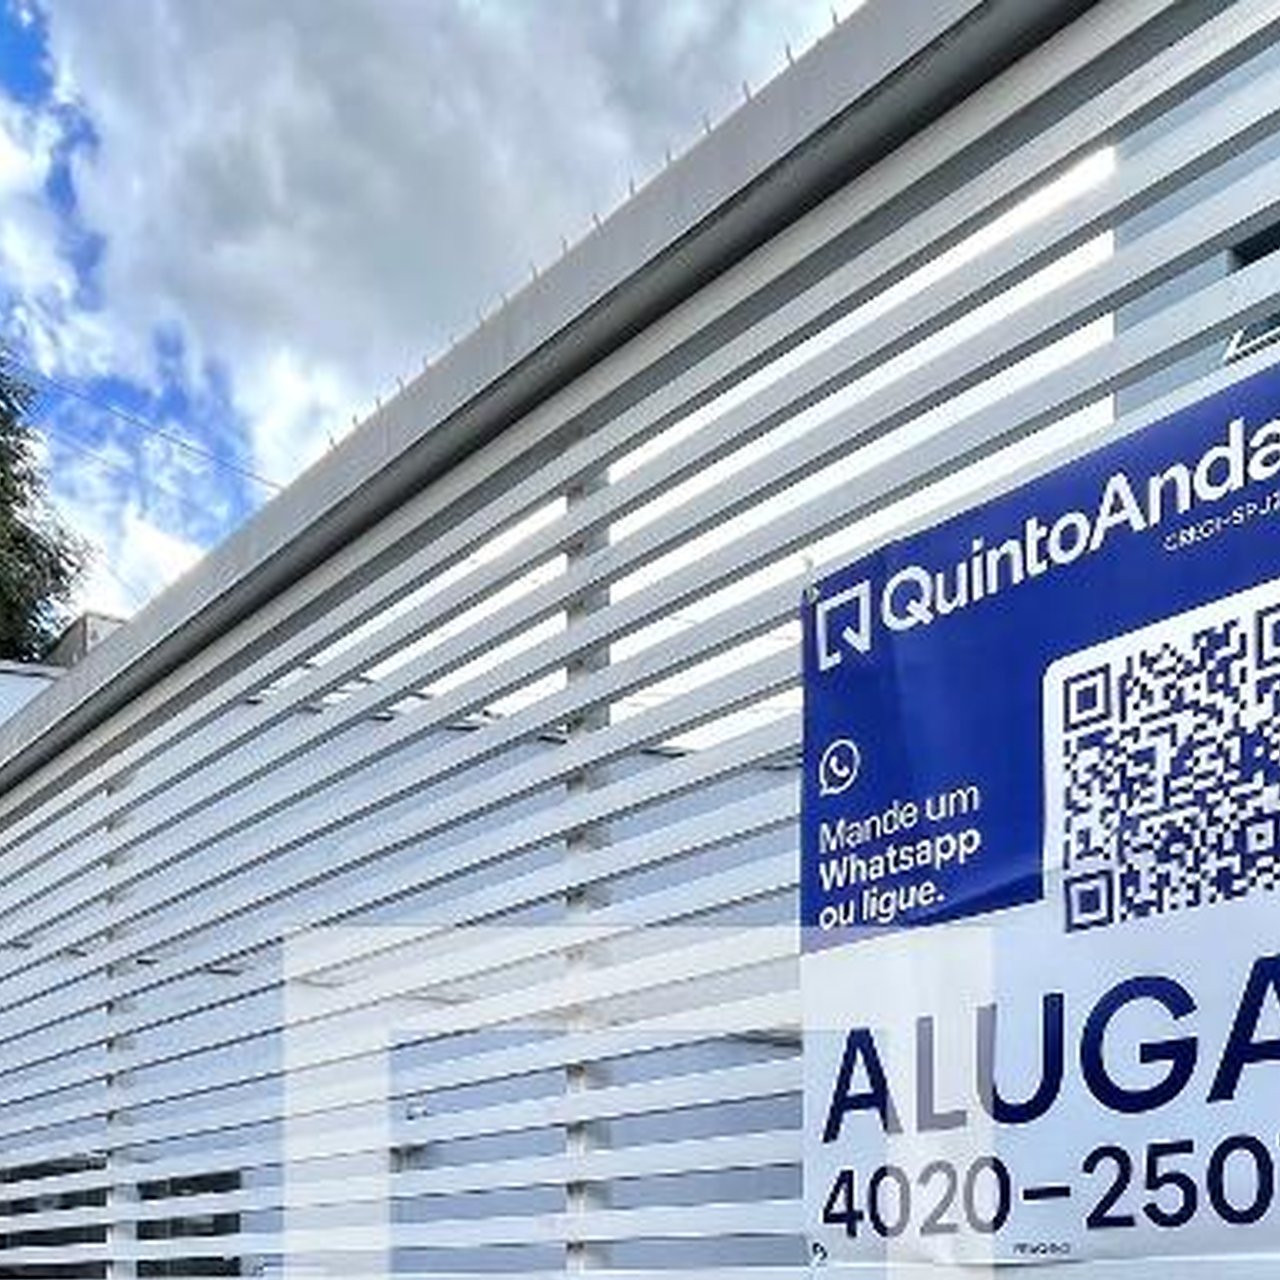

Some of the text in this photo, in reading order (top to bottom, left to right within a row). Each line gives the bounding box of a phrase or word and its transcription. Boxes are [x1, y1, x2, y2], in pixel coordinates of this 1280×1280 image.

[820, 786, 979, 853] Mande um
[820, 829, 981, 891] Whatsapp
[820, 881, 944, 930] ou ligue.
